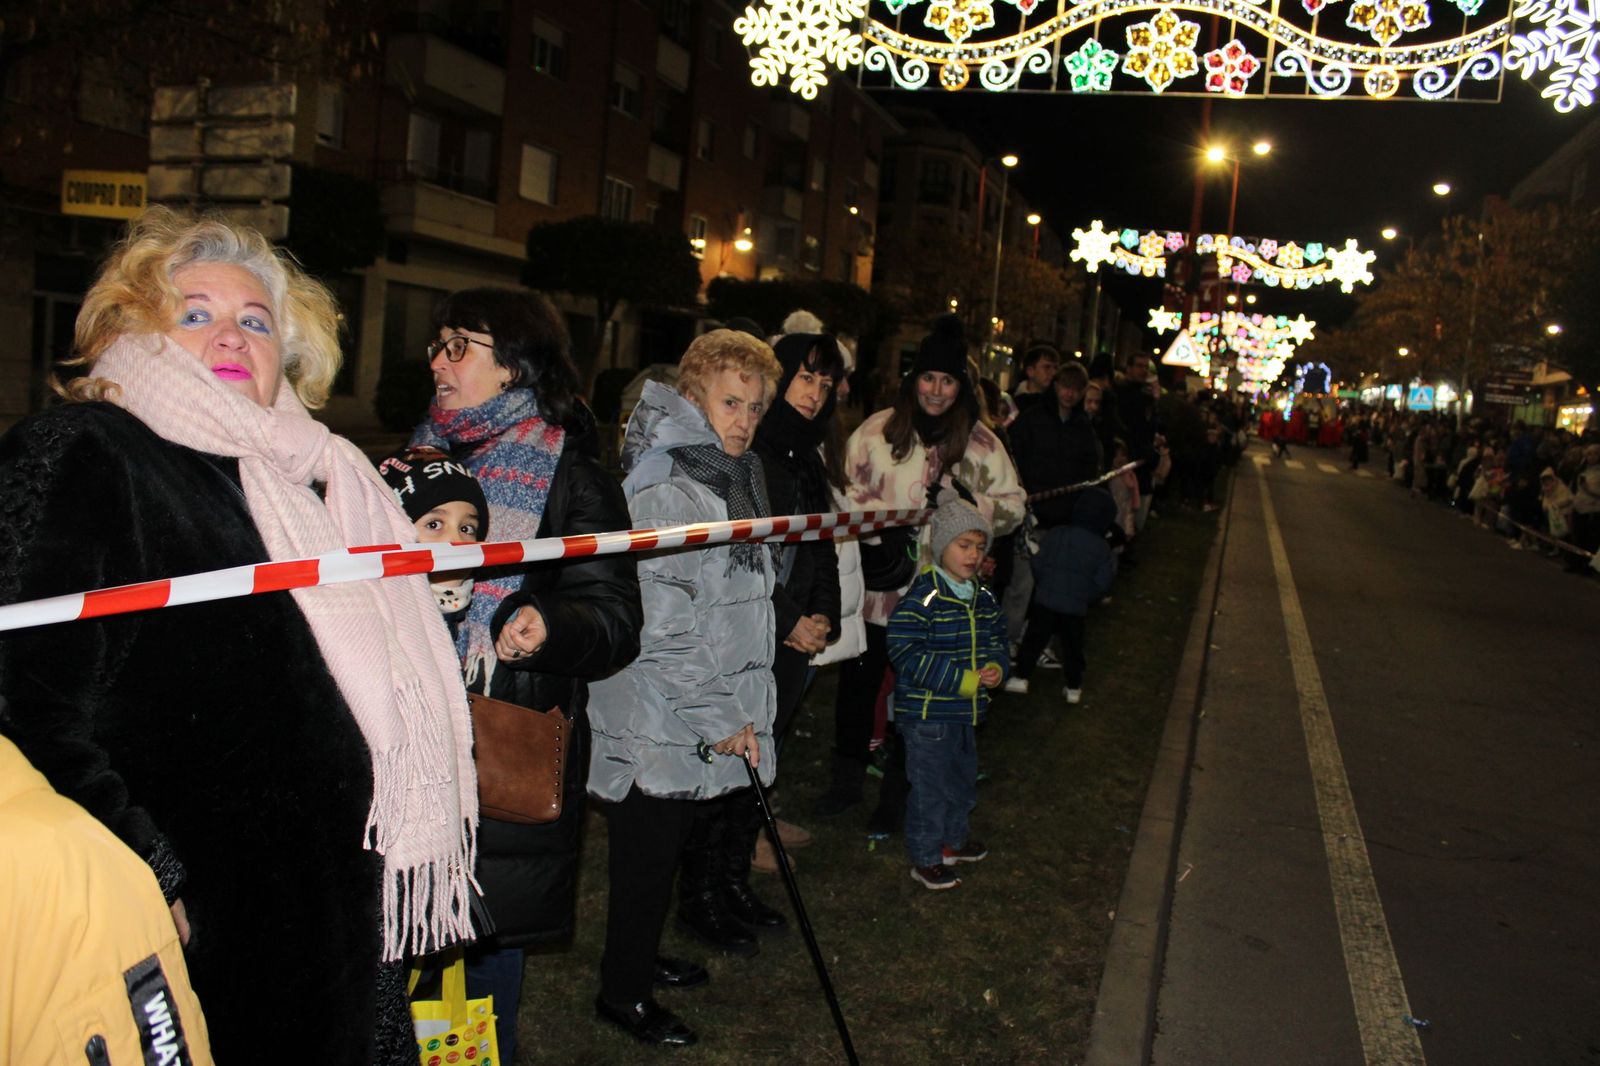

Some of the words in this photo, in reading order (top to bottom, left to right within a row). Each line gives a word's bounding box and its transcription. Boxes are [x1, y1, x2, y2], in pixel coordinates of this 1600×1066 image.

[67, 181, 115, 206] COMPRO
[119, 184, 143, 207] ORO
[423, 461, 472, 480] SN
